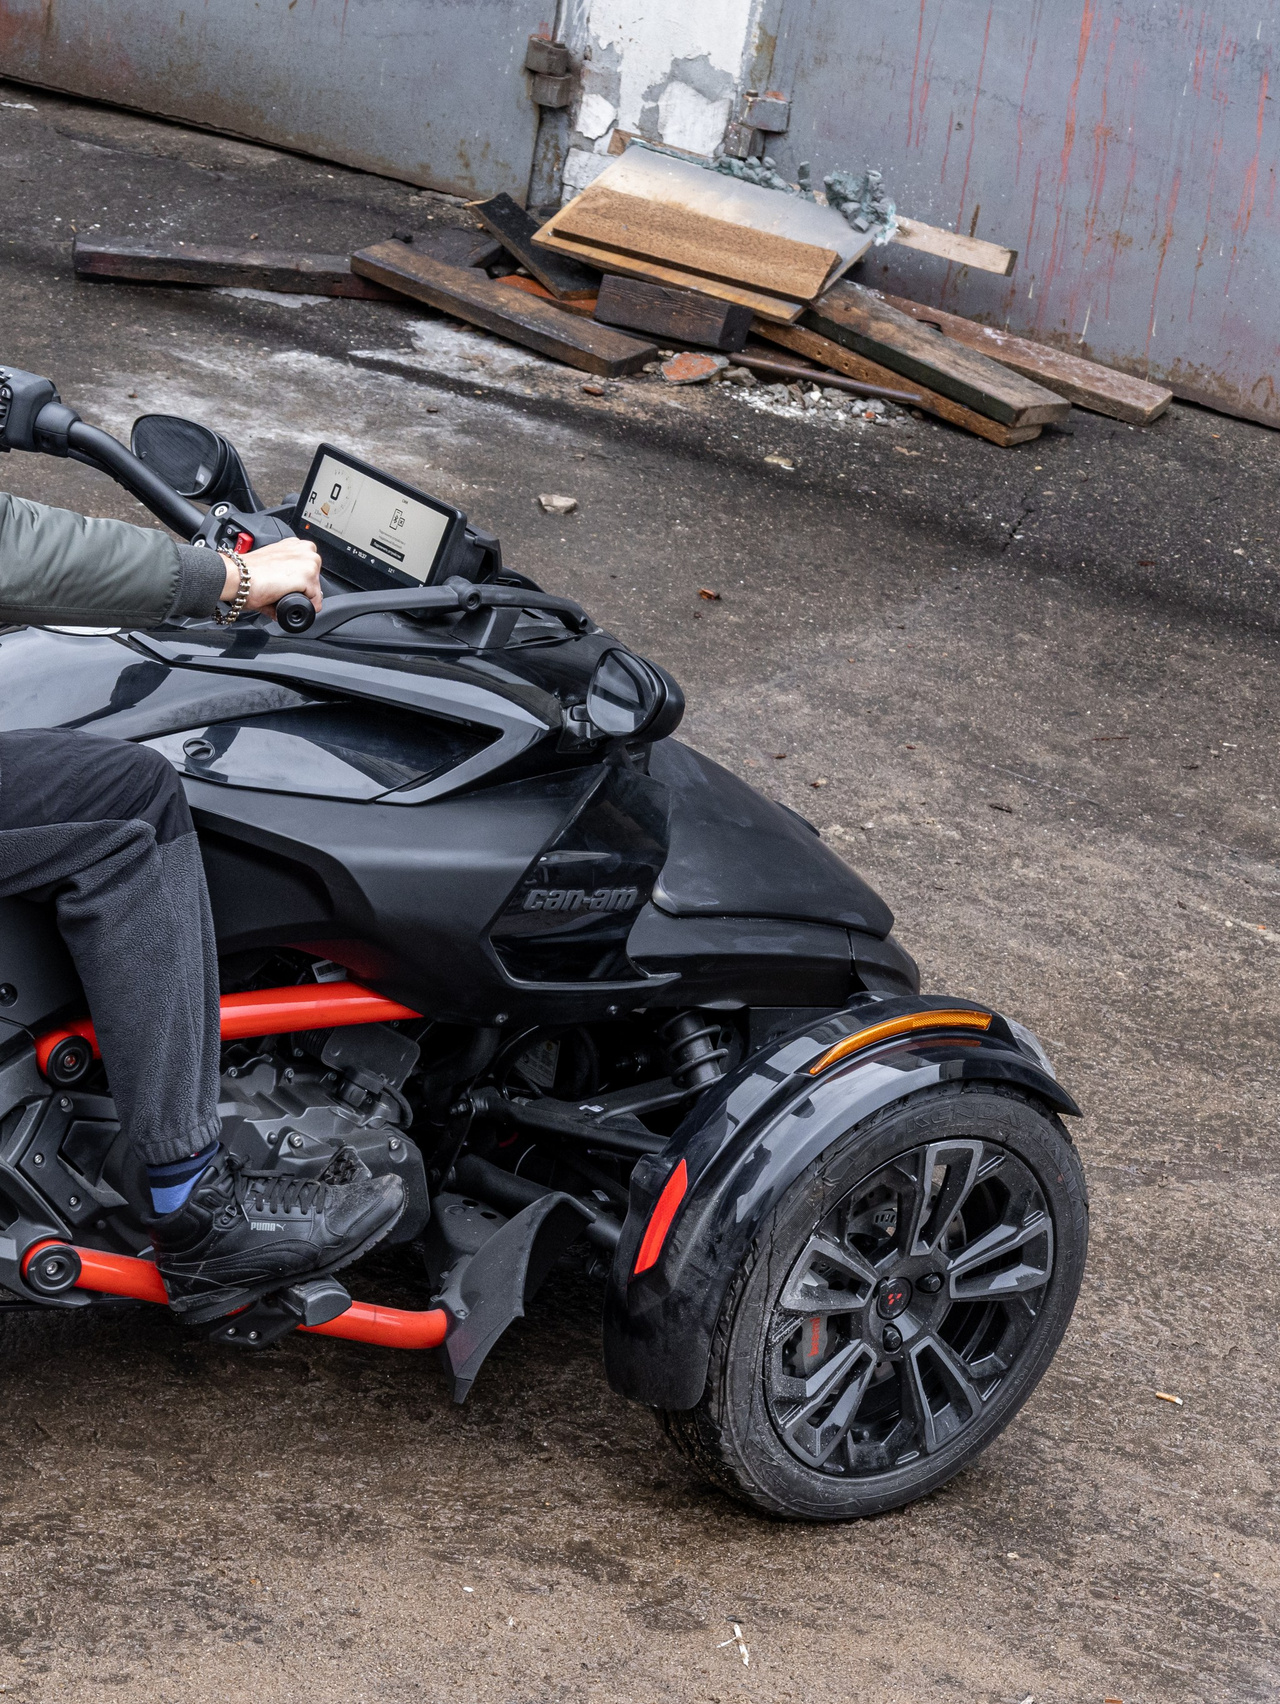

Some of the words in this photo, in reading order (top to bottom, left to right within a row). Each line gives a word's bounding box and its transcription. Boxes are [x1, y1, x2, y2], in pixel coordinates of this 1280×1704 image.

[309, 491, 318, 504] R
[330, 483, 342, 501] 0
[523, 888, 638, 911] can-am
[906, 1103, 1022, 1132] KENDA
[250, 1222, 276, 1232] PUMA
